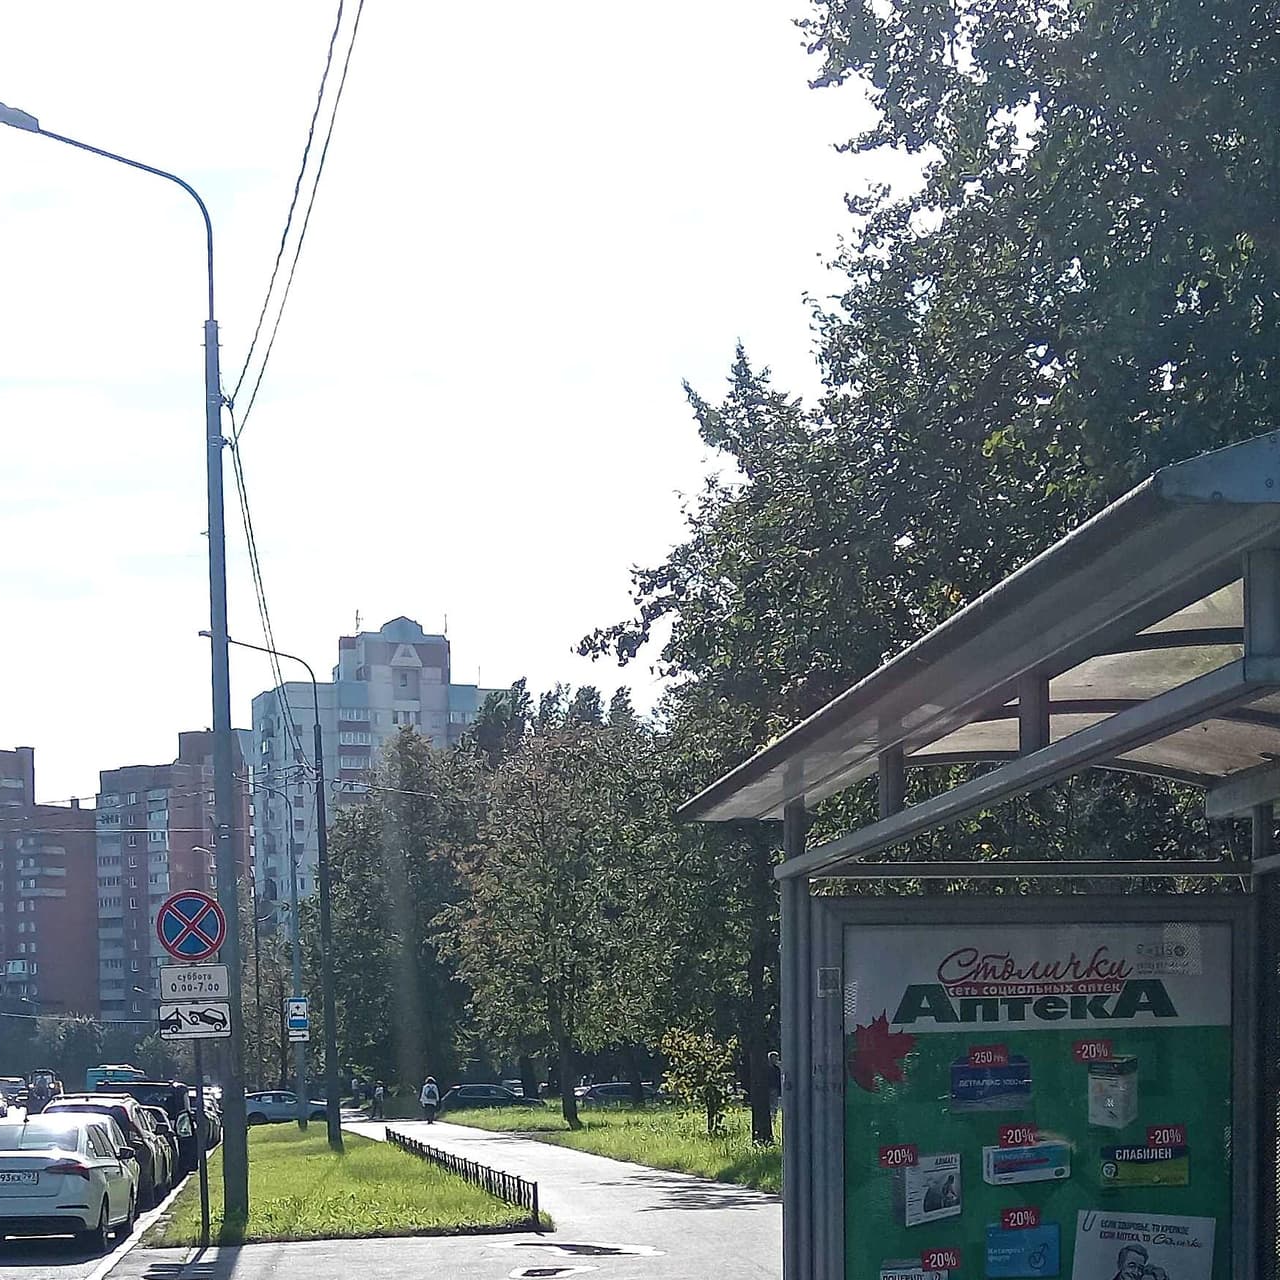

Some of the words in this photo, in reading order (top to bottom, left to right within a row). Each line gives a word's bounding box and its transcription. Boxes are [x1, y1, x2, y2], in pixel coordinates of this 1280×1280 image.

[937, 946, 1134, 984] Столички
[177, 971, 212, 982] суббота
[170, 982, 220, 993] 0.00-7.00
[948, 985, 978, 997] сеть
[982, 982, 1074, 996] социальных
[1077, 981, 1121, 994] аптек
[970, 1050, 993, 1064] -250
[1076, 1043, 1108, 1059] -20%
[1002, 1128, 1035, 1145] -20%
[1149, 1129, 1182, 1145] -20%
[881, 1148, 913, 1165] -20%
[1115, 1148, 1172, 1161] СЛАБИЛЕН
[1003, 1210, 1036, 1226] -20%
[924, 1252, 957, 1269] -20%
